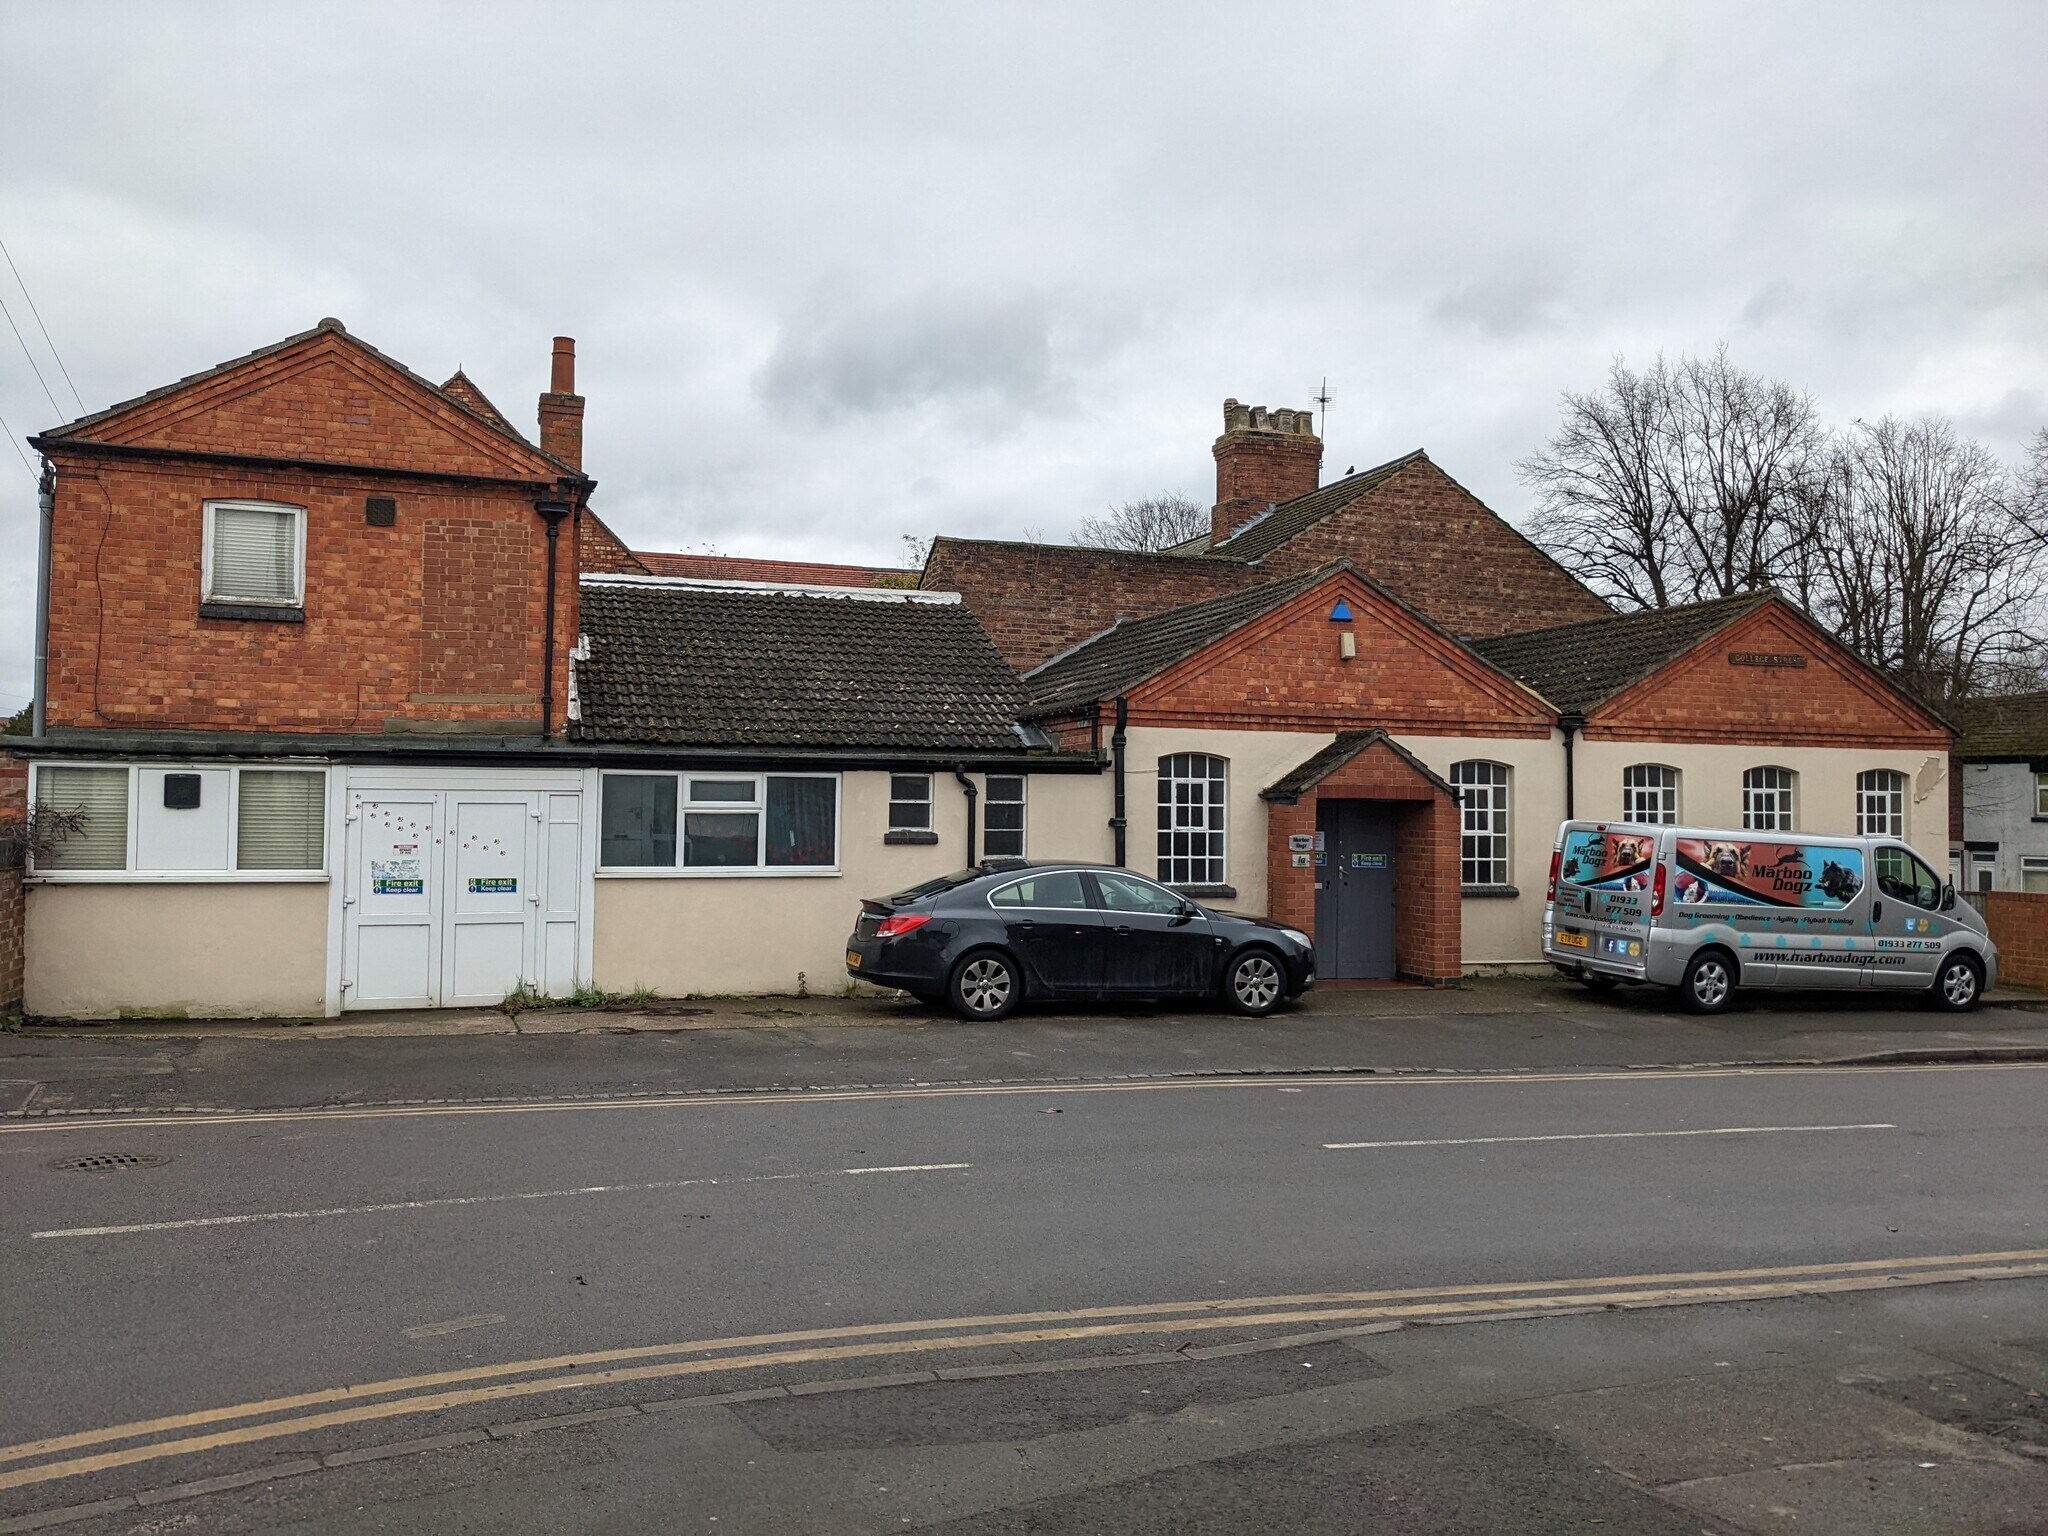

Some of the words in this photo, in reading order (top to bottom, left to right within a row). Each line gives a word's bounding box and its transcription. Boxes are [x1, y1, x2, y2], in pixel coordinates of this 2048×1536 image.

[1735, 654, 1768, 663] COLLEGE
[1572, 845, 1608, 857] Marboo
[1582, 855, 1607, 868] Dogz
[1752, 864, 1813, 879] Marboo
[1772, 879, 1813, 894] Dogz
[1610, 894, 1638, 905] 01933
[1605, 905, 1622, 914] 277
[1623, 907, 1642, 917] 509
[1565, 912, 1634, 926] www.marboodogz.com
[1678, 912, 1694, 920] Dog
[1694, 912, 1730, 921] Grooming
[1735, 913, 1772, 921] Obedience
[1775, 915, 1799, 923] Agility
[1803, 916, 1827, 924] Flyball
[1827, 917, 1855, 926] Training
[1878, 940, 1905, 948] 01933
[1924, 941, 1941, 949] 509
[1753, 952, 1906, 966] www.marboodogz.com
